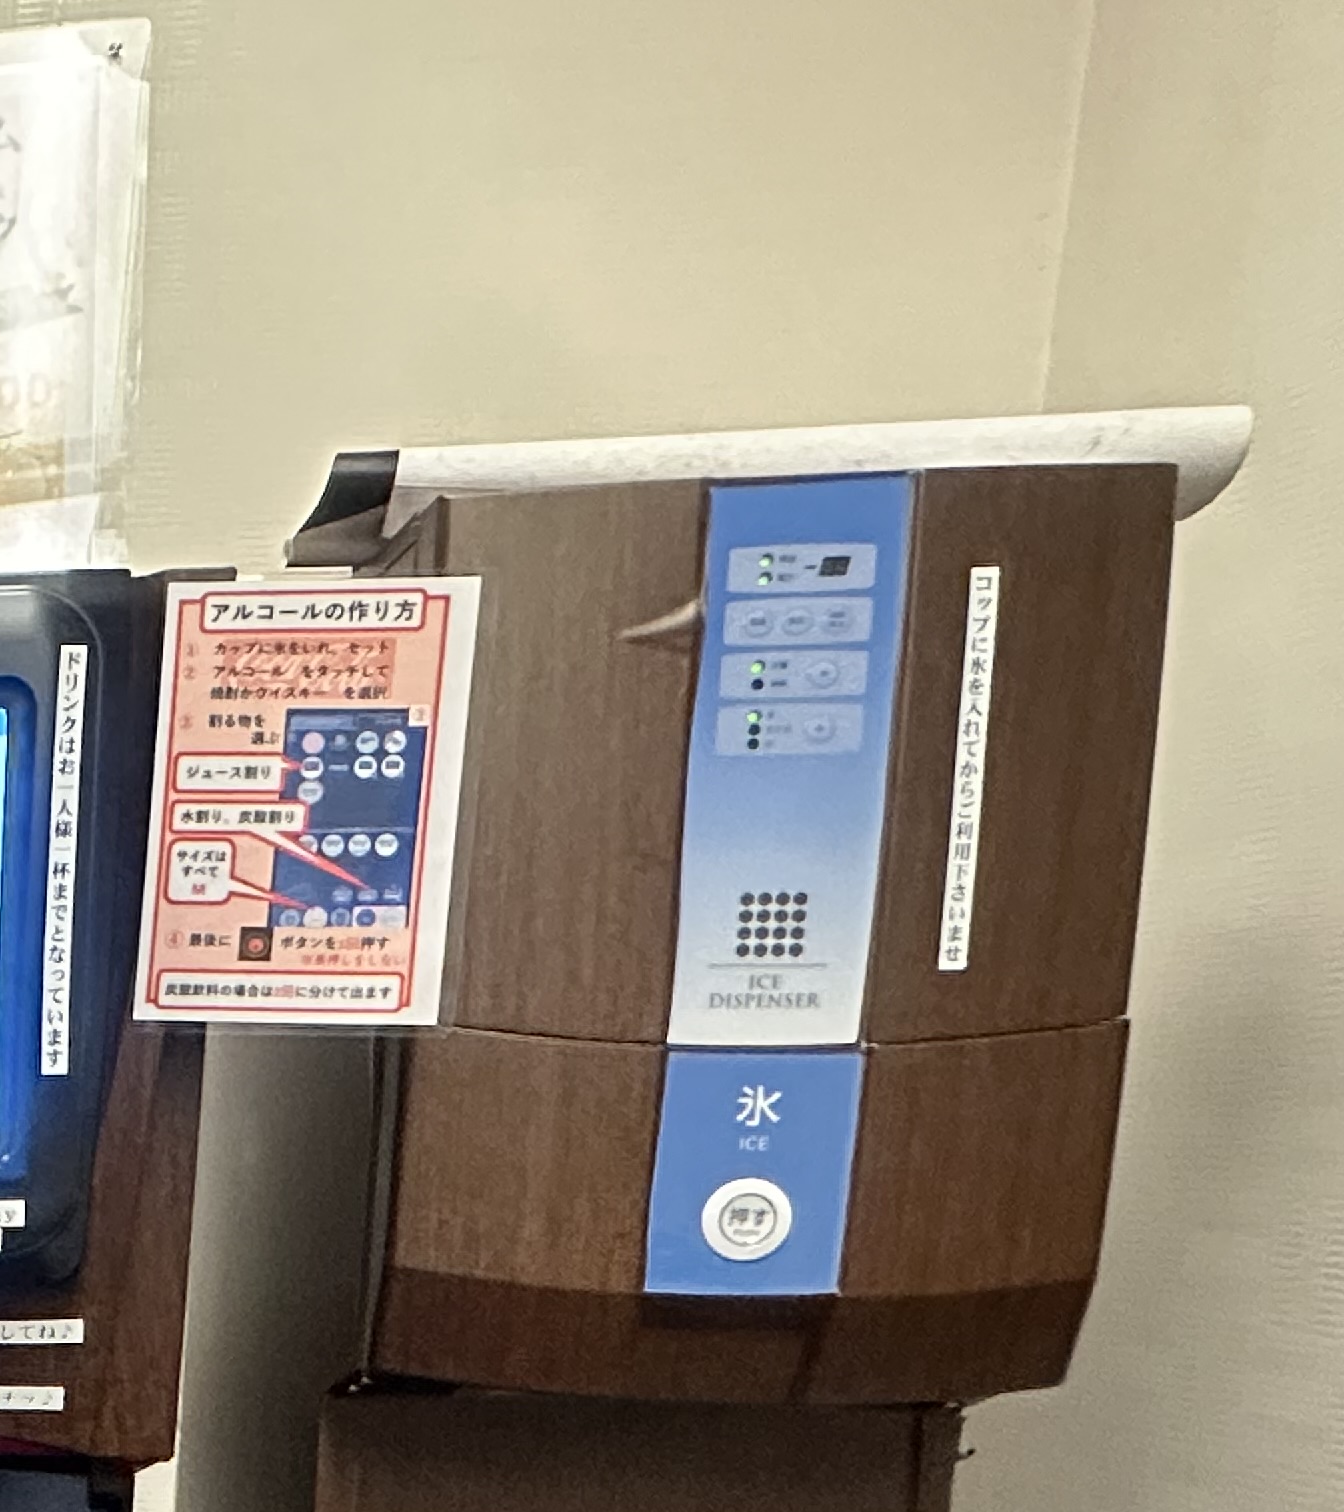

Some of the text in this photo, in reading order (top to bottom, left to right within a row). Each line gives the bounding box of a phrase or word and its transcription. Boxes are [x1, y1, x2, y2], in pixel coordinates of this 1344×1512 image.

[211, 600, 417, 622] アルコールの作り方
[186, 765, 271, 779] ジュース割り
[176, 850, 226, 863] サイズは
[182, 865, 219, 877] すべて
[748, 974, 784, 989] ICE
[709, 992, 820, 1008] DISPENSER
[737, 1085, 781, 1126] 氷
[739, 1136, 768, 1150] ICE
